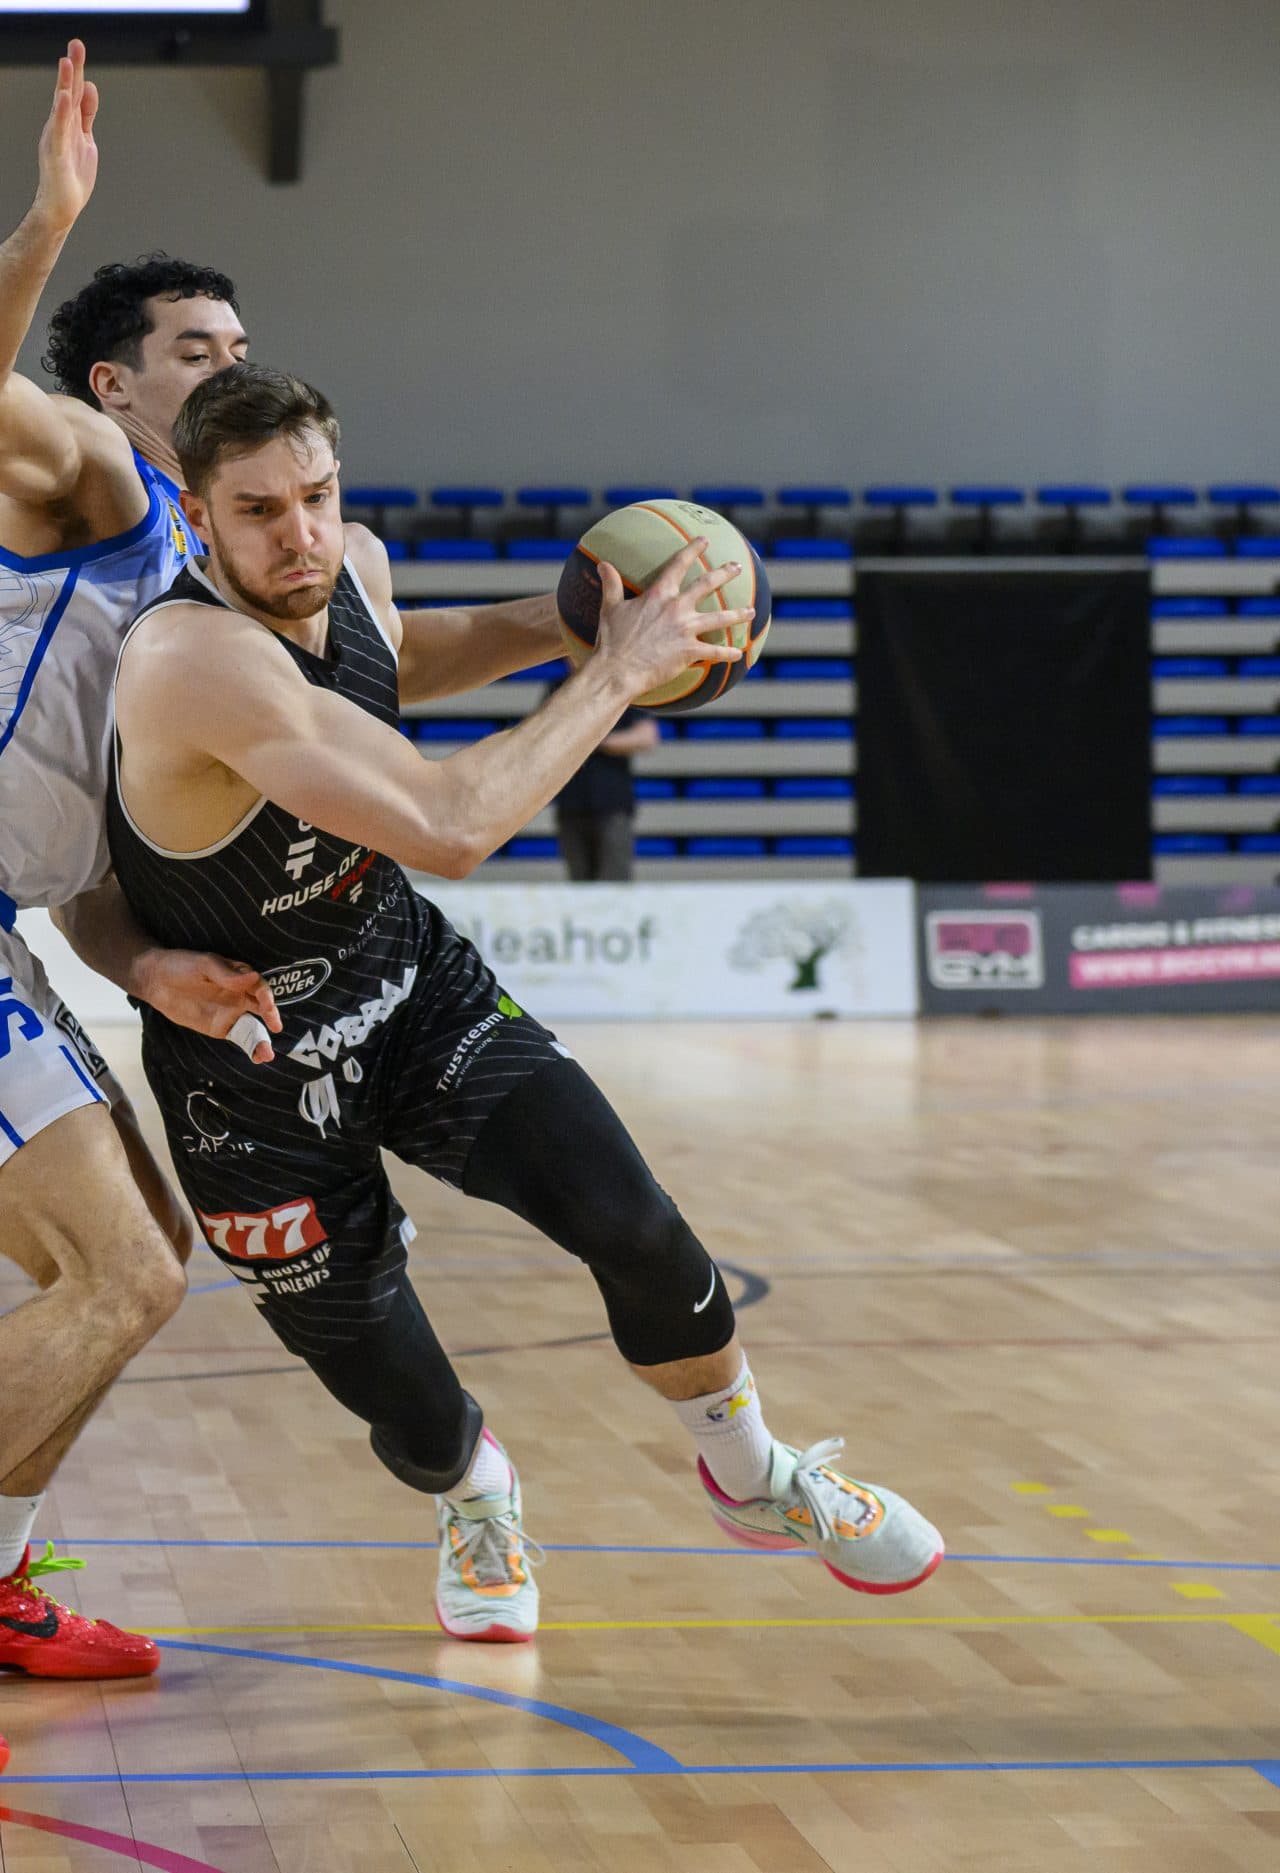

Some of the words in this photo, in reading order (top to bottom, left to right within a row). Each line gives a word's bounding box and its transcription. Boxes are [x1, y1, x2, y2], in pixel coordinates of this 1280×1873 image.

[261, 871, 336, 917] HOUSE
[338, 846, 361, 878] OF
[457, 914, 657, 965] leahof
[268, 968, 312, 987] AND-
[273, 974, 316, 997] OVER
[436, 1012, 505, 1092] Trustteam
[201, 1202, 311, 1256] 777
[262, 1259, 312, 1280] HOUSE
[271, 1268, 330, 1295] TALENTS
